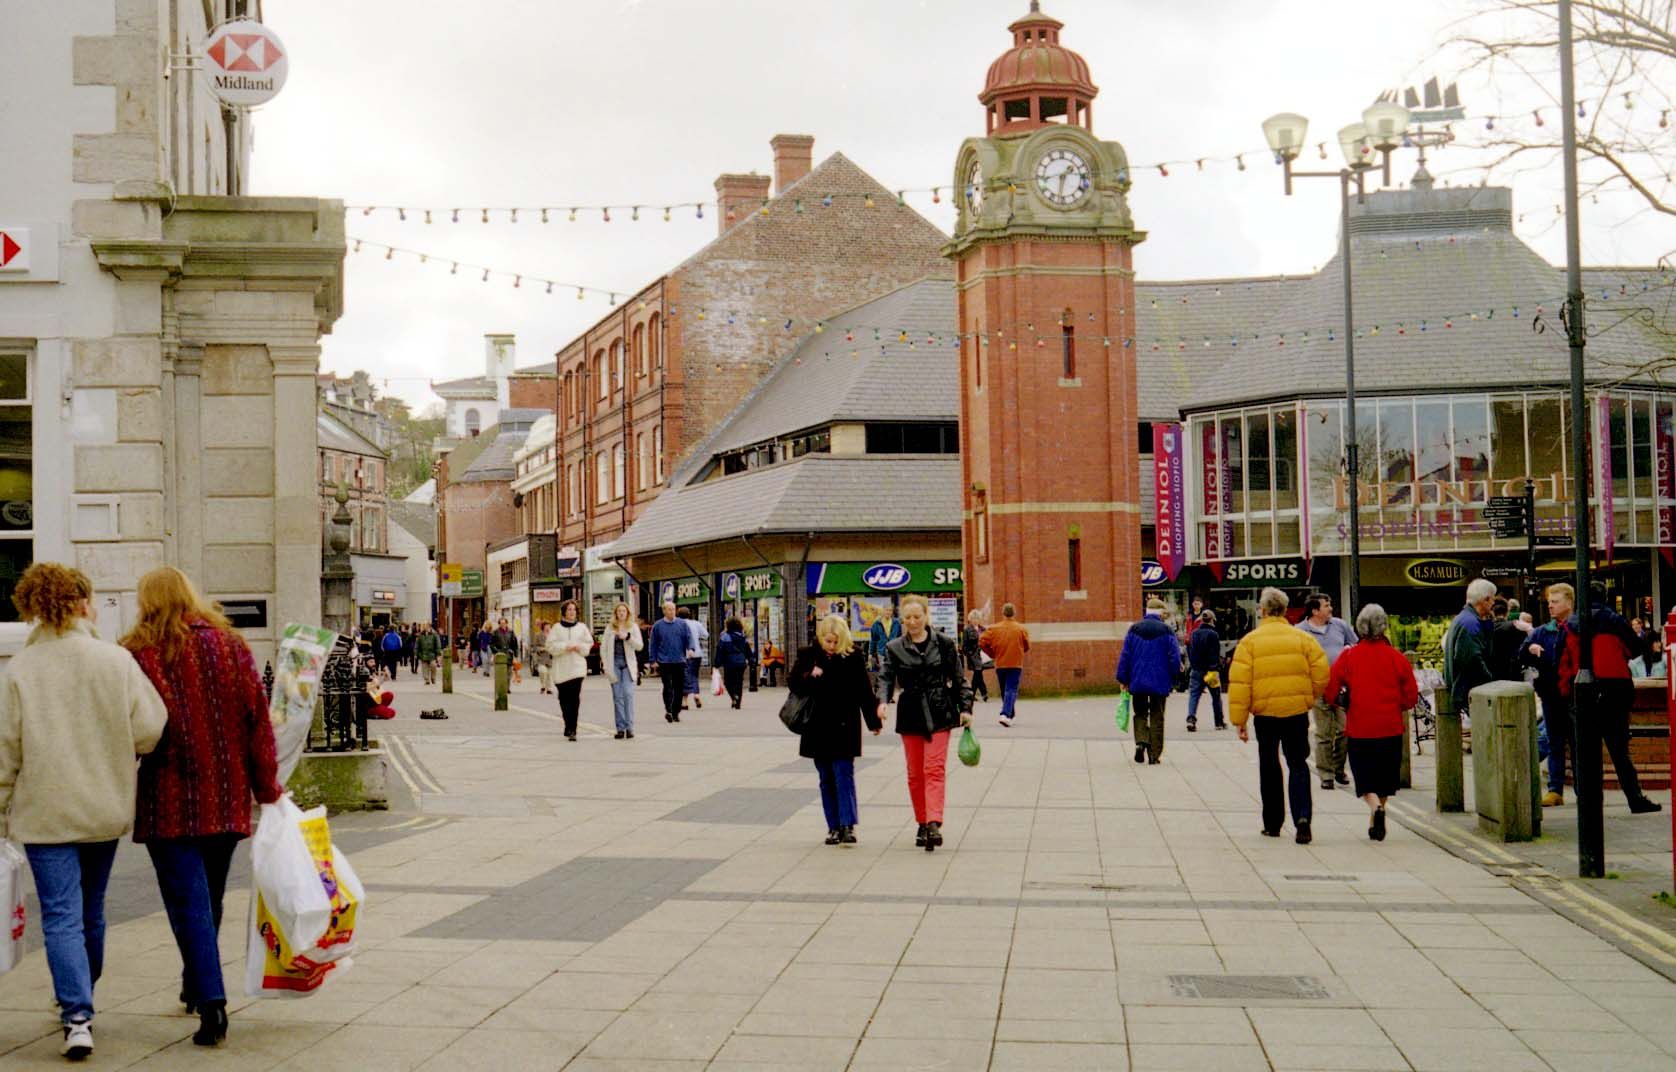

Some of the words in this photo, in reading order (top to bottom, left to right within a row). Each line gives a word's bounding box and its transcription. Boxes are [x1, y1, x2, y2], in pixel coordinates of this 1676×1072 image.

[214, 76, 274, 90] Midland
[1172, 456, 1180, 492] SIOPIO
[1157, 456, 1171, 556] DEINIOL
[1173, 501, 1182, 555] SHOPPING
[867, 569, 906, 585] JJB
[933, 567, 964, 584] SP
[1226, 563, 1298, 580] SPORTS
[677, 582, 700, 598] SPORTS
[744, 574, 771, 591] SPORTS
